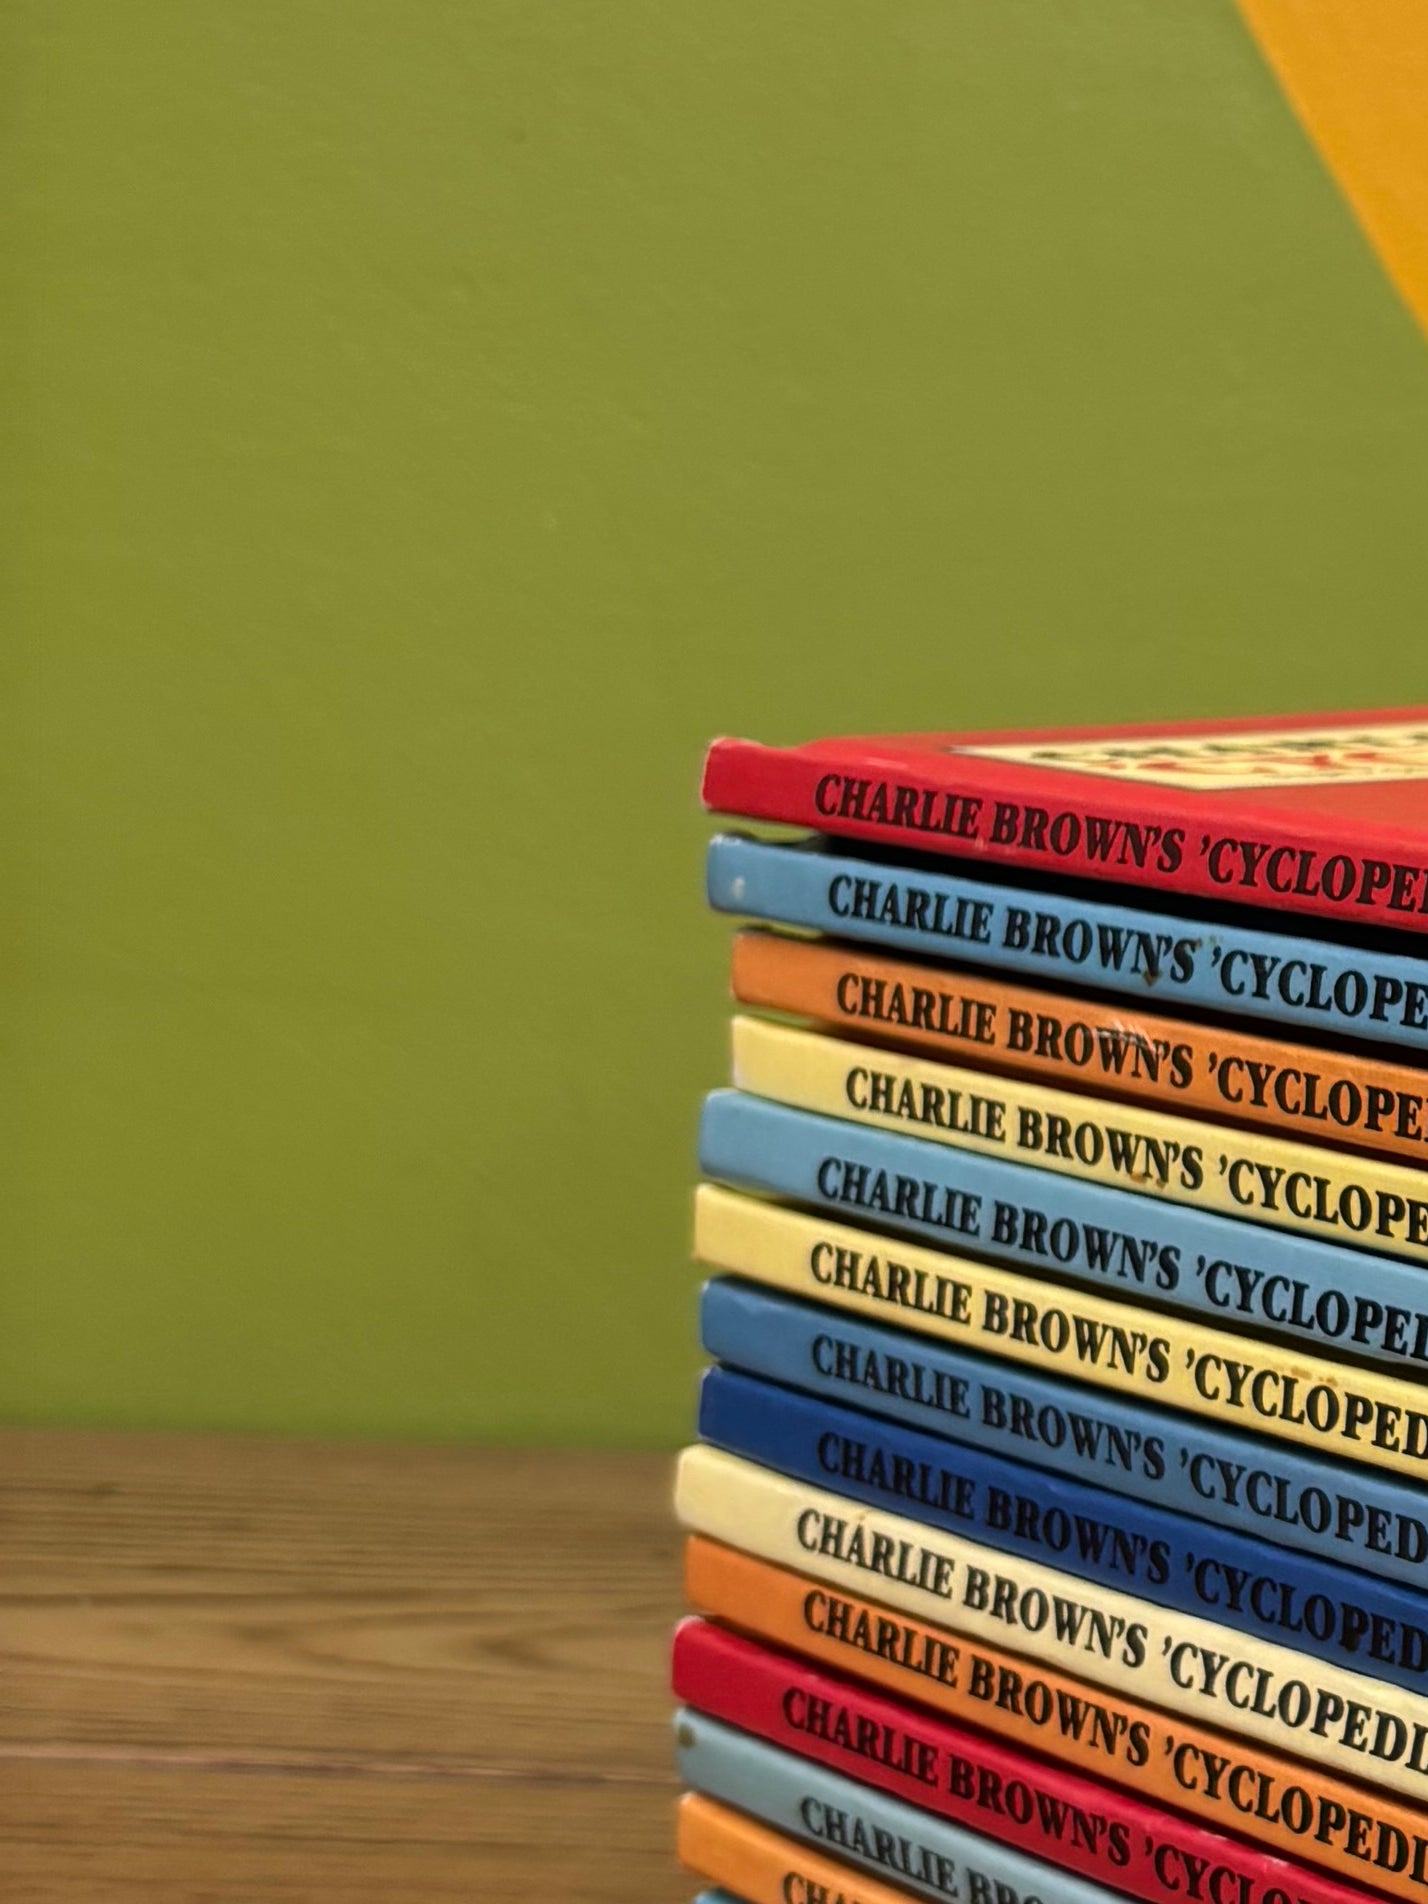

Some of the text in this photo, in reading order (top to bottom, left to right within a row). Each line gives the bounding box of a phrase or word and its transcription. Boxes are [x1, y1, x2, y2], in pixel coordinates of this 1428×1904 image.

[815, 775, 982, 839] CHARLIE
[989, 802, 1185, 873] BROWN'S
[828, 875, 994, 944] CHARLIE
[1001, 907, 1202, 981] BROWN'S
[836, 973, 997, 1045] CHARLIE
[1006, 1008, 1193, 1089] BROWN'S
[845, 1067, 1006, 1142] CHARLIE
[1017, 1107, 1203, 1191] BROWN'S
[816, 1157, 982, 1237] CHARLIE
[990, 1200, 1181, 1291] BROWN'S
[810, 1242, 972, 1325] CHARLIE
[981, 1290, 1170, 1383] BROWN'S
[811, 1335, 970, 1419] CHARLIE
[981, 1385, 1165, 1481] BROWN'S
[816, 1432, 975, 1521] CHARLIE
[985, 1486, 1170, 1585] BROWN'S
[797, 1509, 954, 1599] CHARLIE
[962, 1565, 1148, 1669] BROWN'S
[803, 1591, 959, 1688] CHARLIE
[967, 1656, 1150, 1767] BROWN'S
[782, 1689, 937, 1786] CHARLIE
[949, 1756, 1130, 1867] BROWN'S
[799, 1797, 959, 1898] CHARLIE
